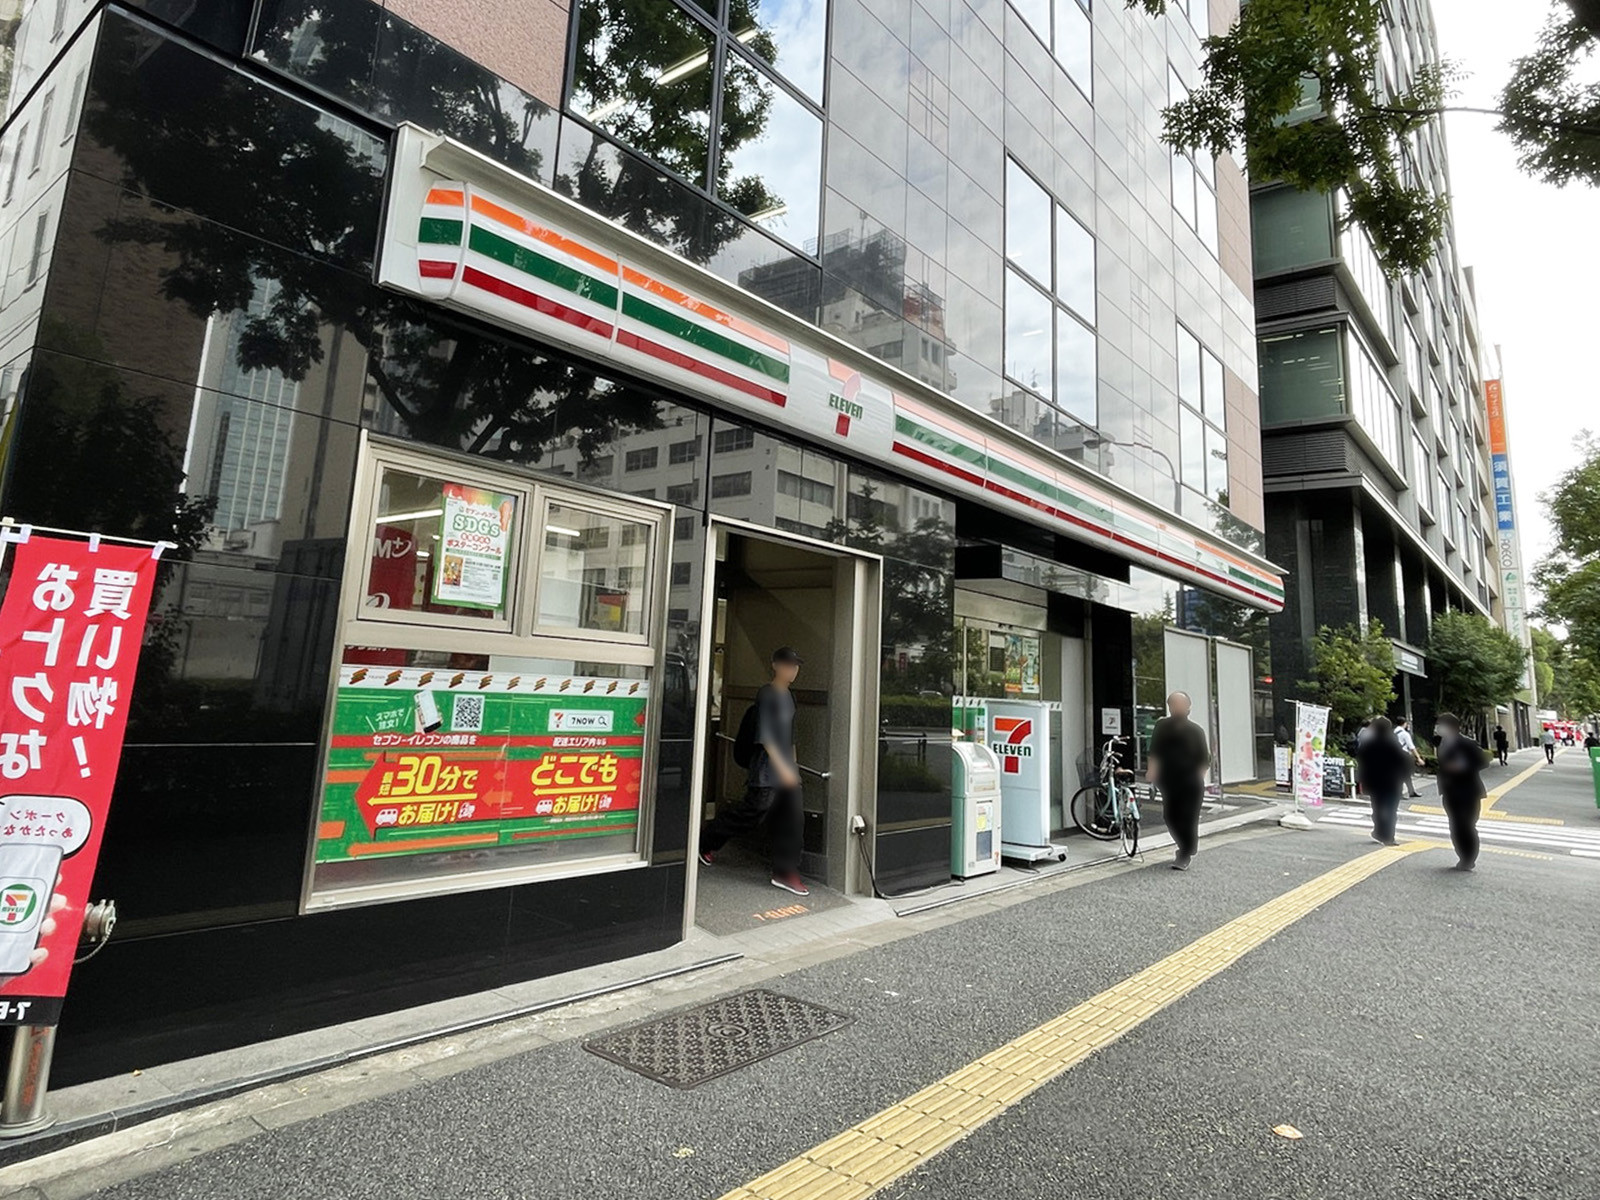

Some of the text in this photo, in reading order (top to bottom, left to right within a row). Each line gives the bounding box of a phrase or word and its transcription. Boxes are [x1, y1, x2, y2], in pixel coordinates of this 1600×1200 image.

[453, 513, 500, 538] SDGs
[571, 716, 595, 726] 7NOW
[390, 755, 479, 796] 30分で
[531, 754, 618, 786] どこでも
